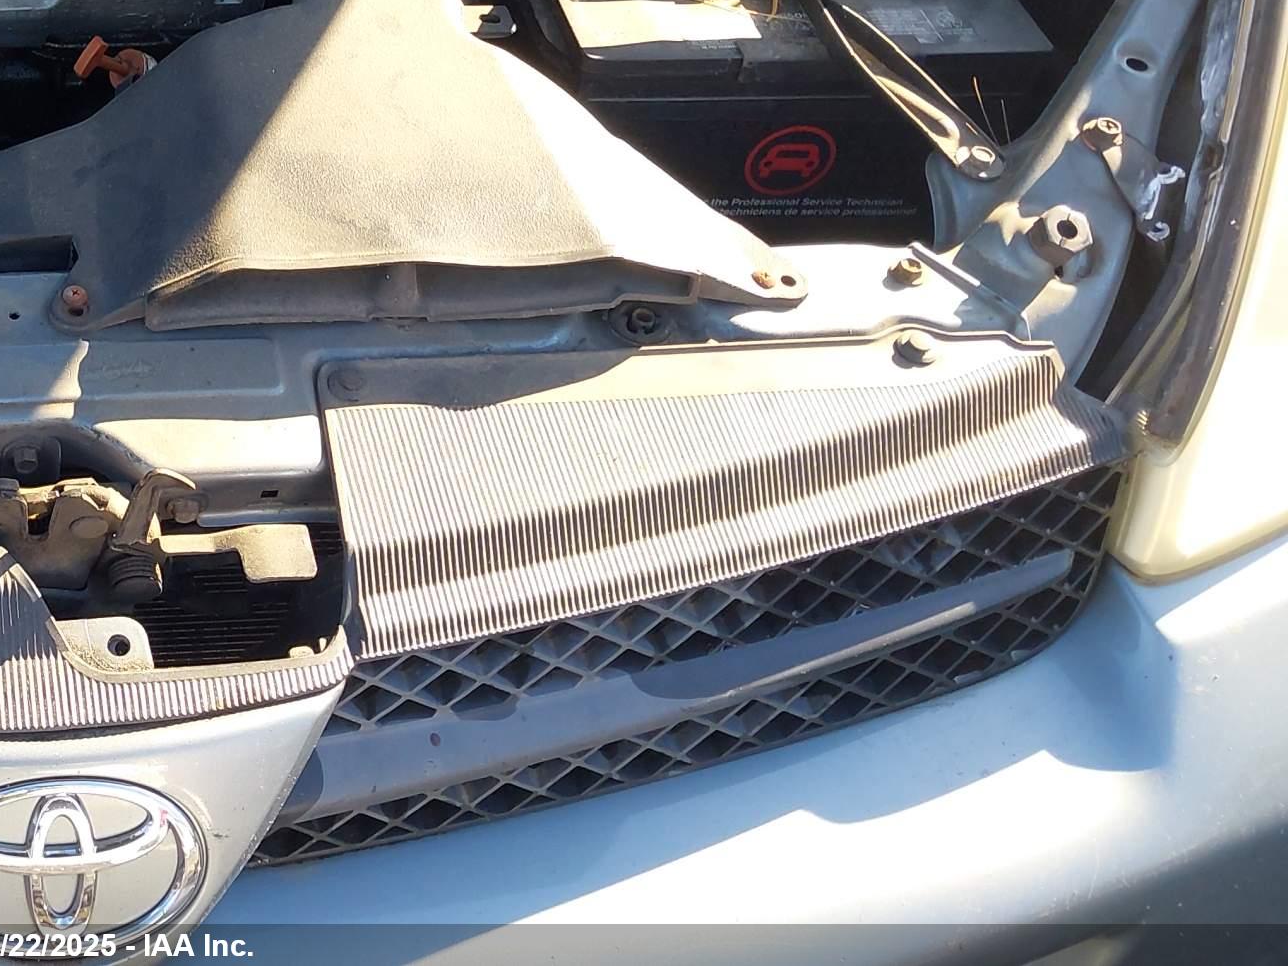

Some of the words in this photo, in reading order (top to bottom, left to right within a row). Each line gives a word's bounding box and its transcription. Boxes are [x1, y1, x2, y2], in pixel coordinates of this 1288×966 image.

[711, 198, 728, 207] the
[731, 197, 800, 207] Professional
[801, 197, 843, 206] Service
[846, 197, 904, 206] Technician
[784, 208, 799, 216] de
[800, 208, 841, 216] service
